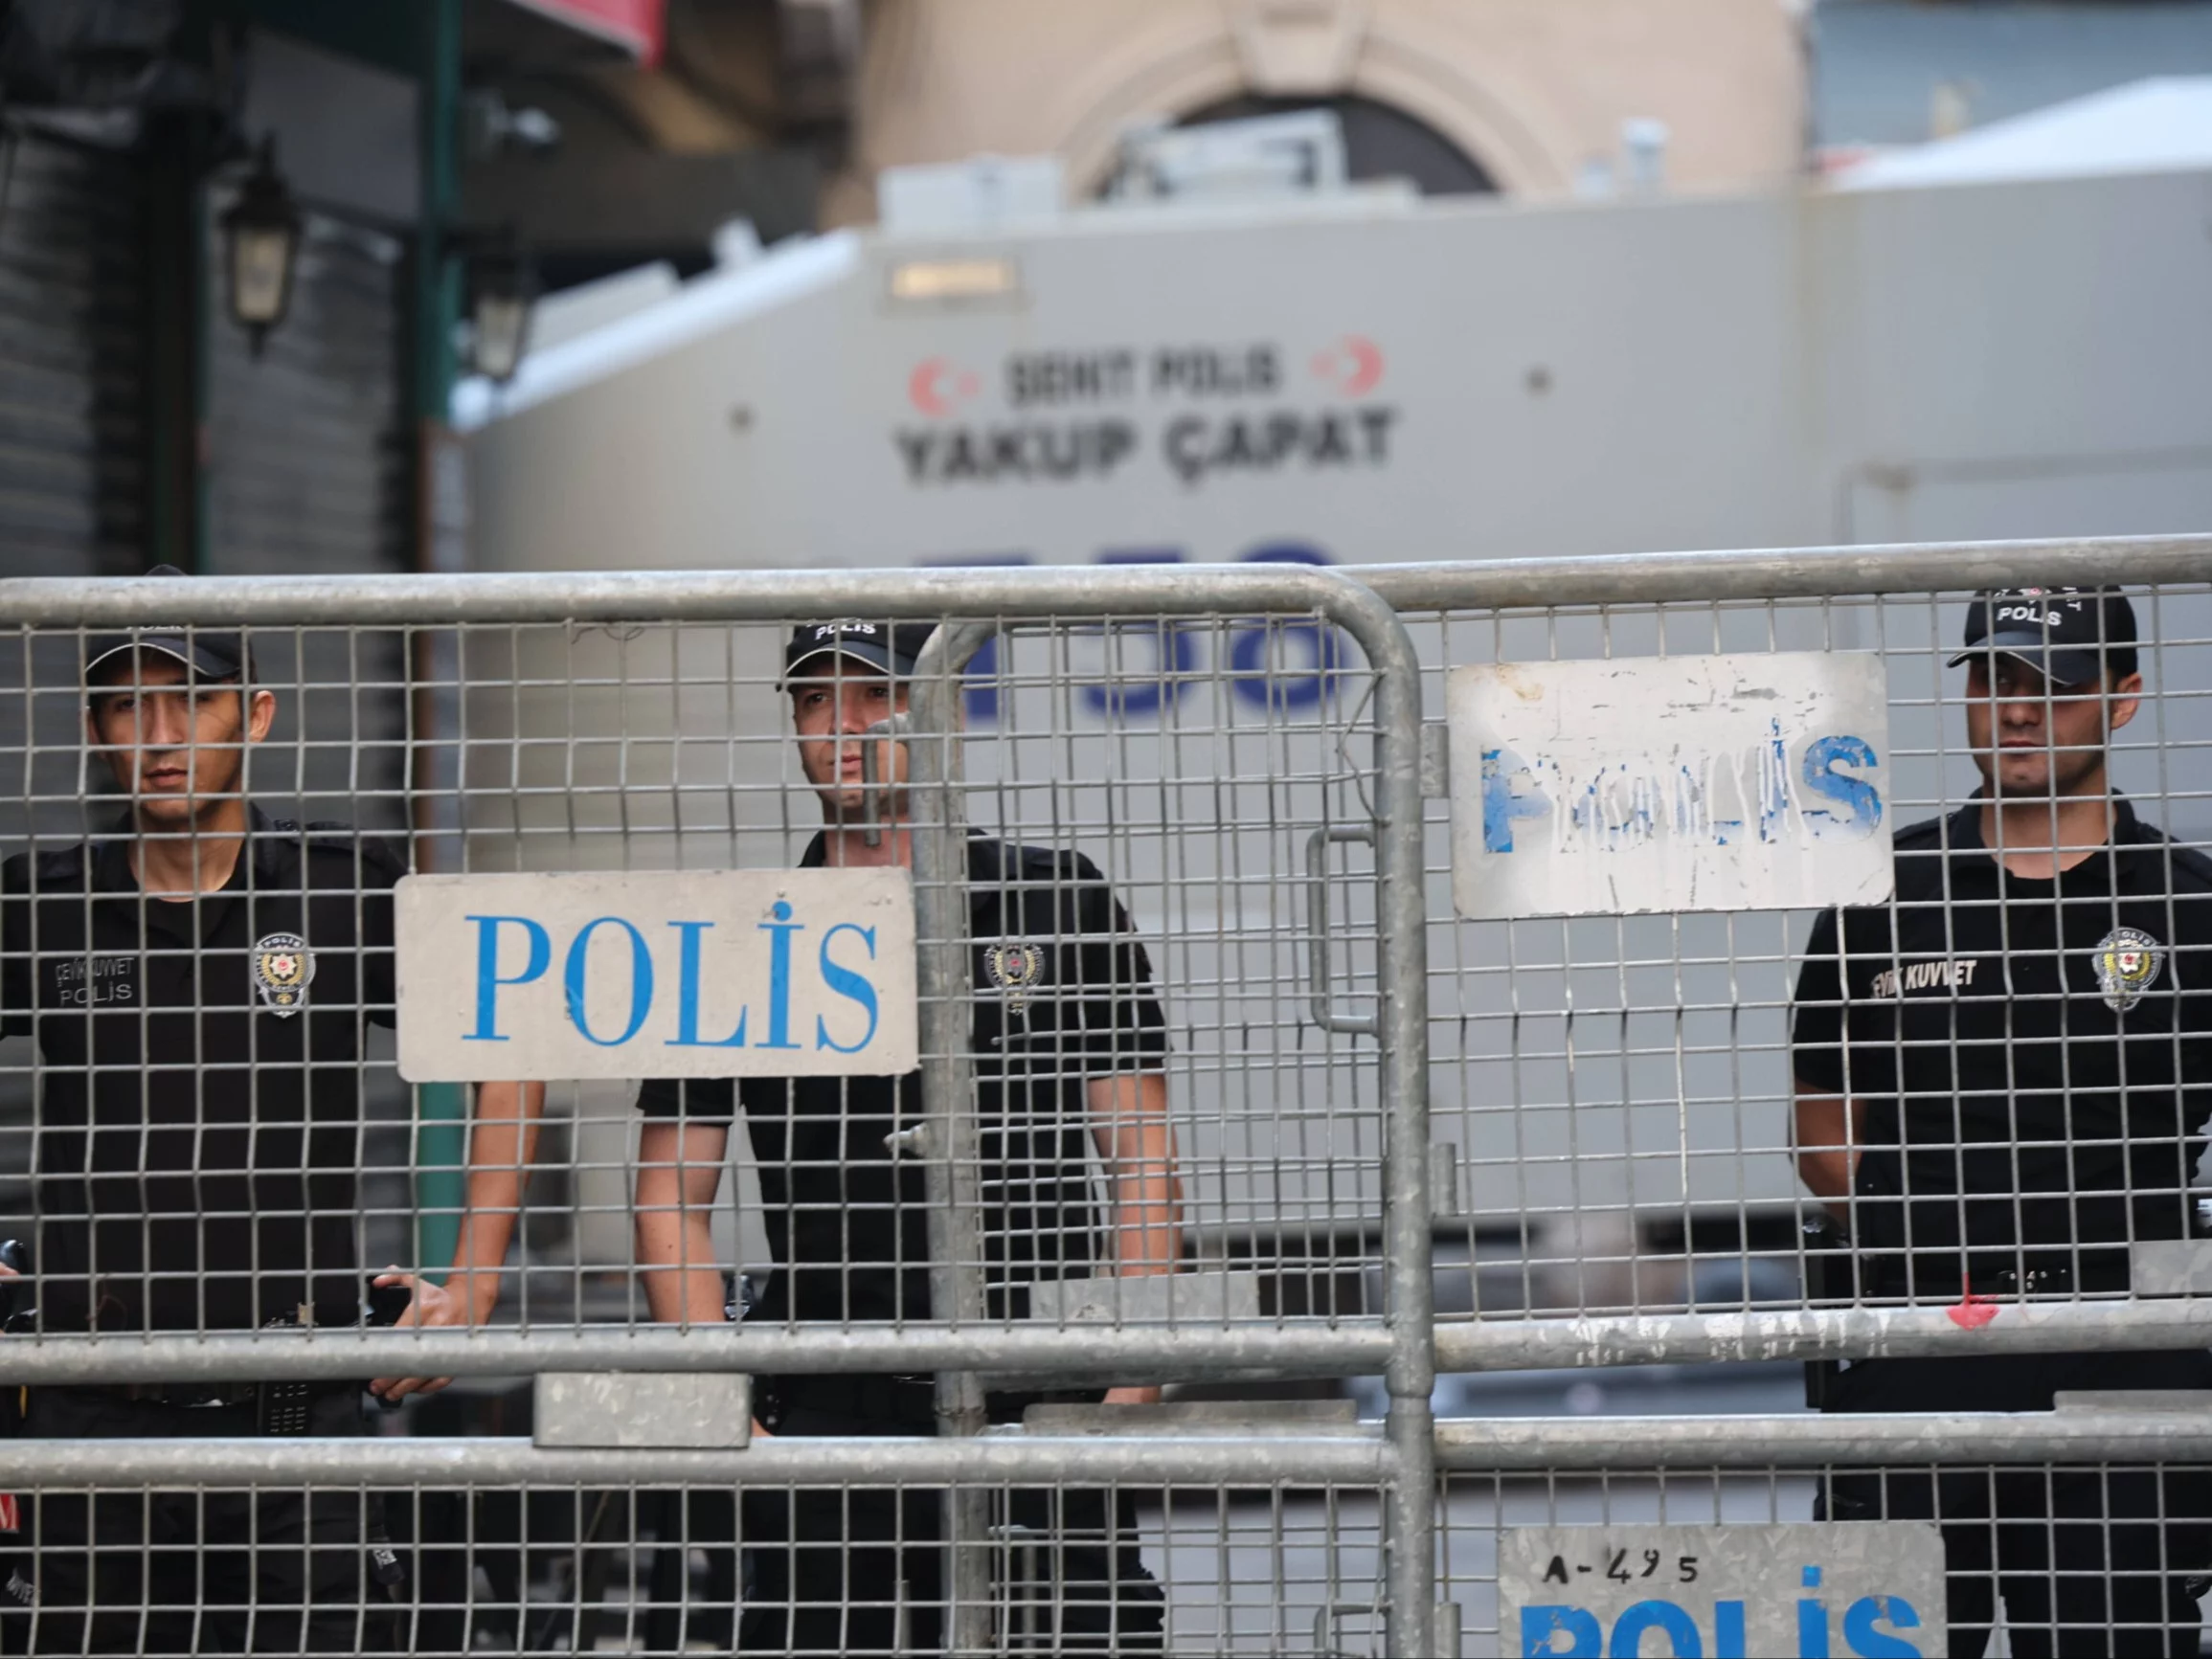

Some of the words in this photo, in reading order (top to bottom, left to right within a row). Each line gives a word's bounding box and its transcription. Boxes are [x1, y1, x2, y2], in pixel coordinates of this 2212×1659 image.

[895, 420, 1137, 482] YAKUP
[1162, 405, 1397, 492] ÇAPAT
[1997, 606, 2062, 626] POLS
[462, 900, 879, 1054] POLİS
